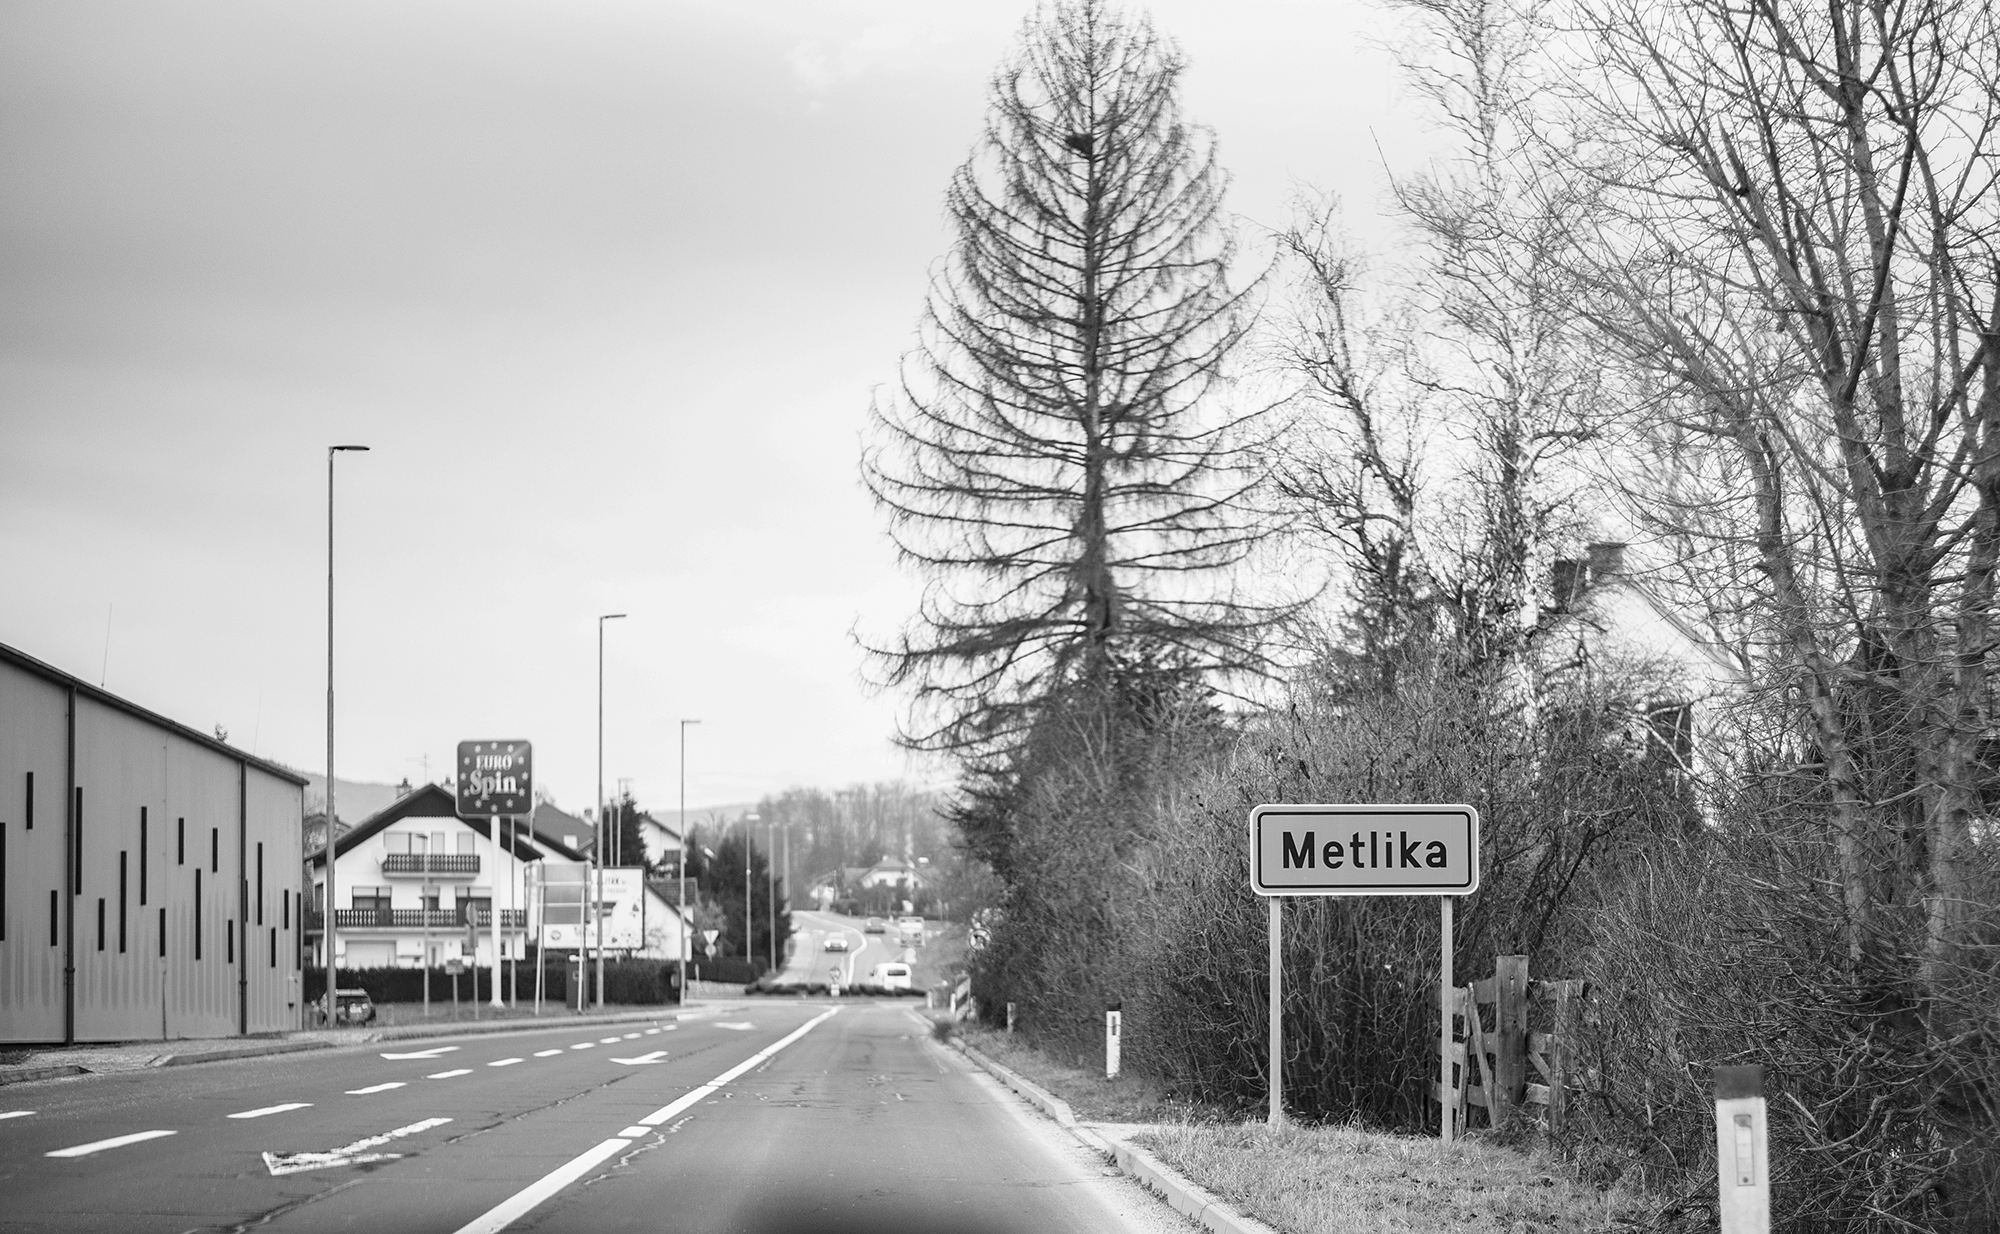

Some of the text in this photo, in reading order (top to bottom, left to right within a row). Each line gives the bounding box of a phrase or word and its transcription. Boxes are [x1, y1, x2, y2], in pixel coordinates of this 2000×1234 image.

[476, 754, 512, 771] EURO
[469, 769, 517, 801] Spin
[1282, 831, 1447, 869] Metlika
